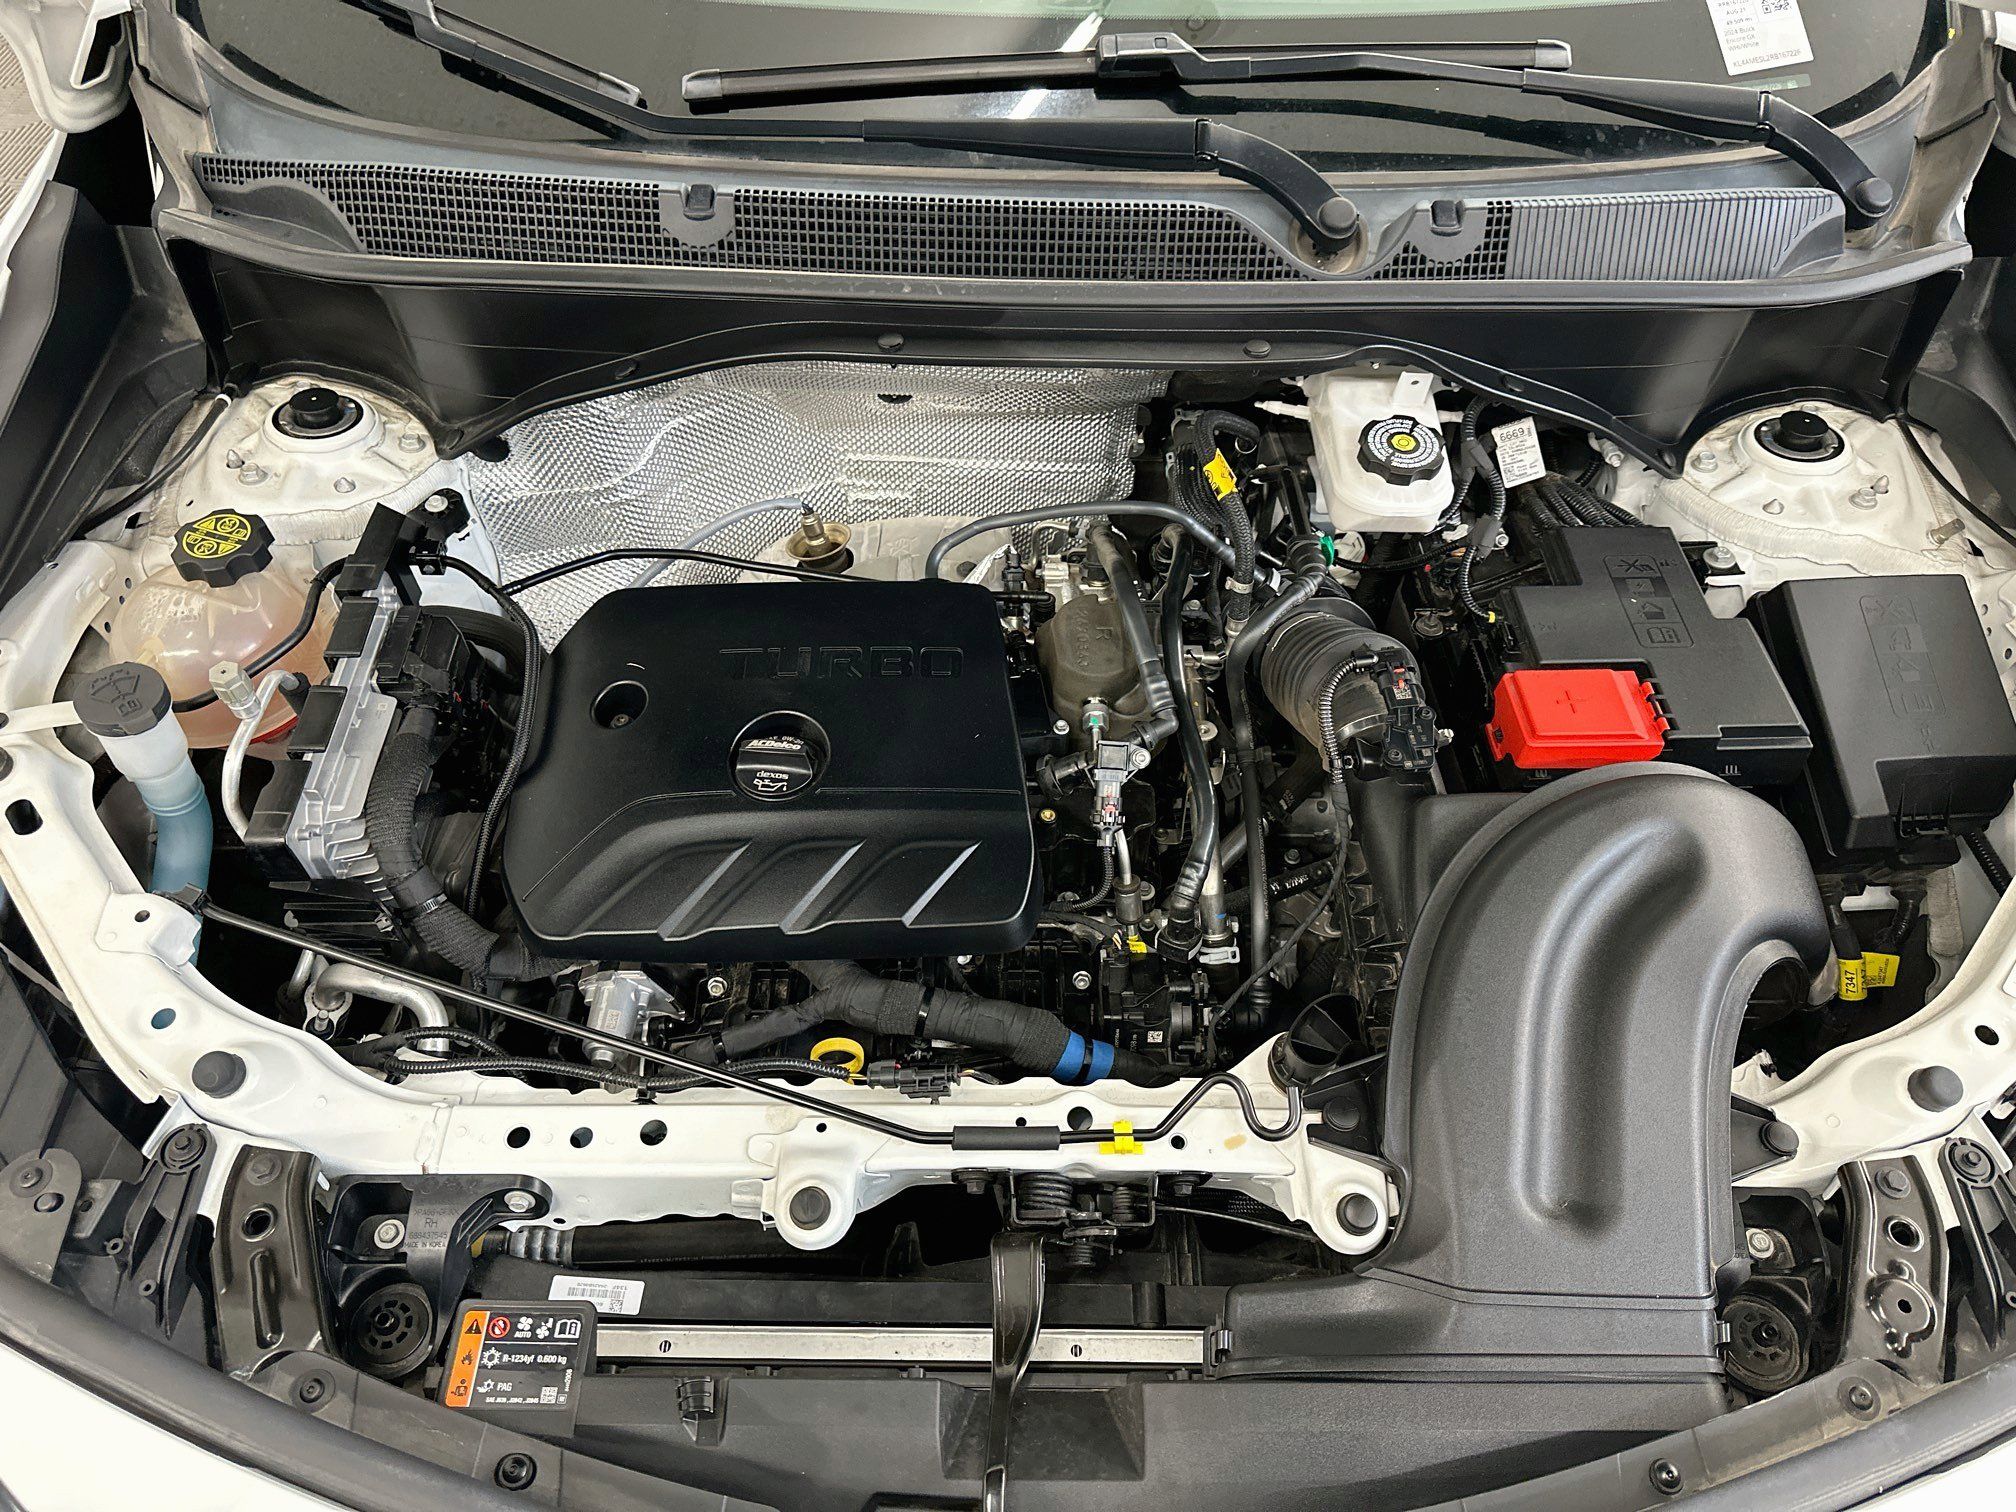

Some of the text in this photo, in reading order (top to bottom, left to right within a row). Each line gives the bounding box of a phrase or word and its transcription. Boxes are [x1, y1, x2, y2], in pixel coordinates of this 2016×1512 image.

[1739, 26, 1756, 34] Buick
[1500, 427, 1525, 442] 6669
[720, 646, 963, 678] TURBO
[745, 740, 801, 750] ACDelco
[756, 770, 789, 780] dexos
[1844, 970, 1856, 994] 7347
[424, 1218, 438, 1228] RH
[502, 1354, 568, 1365] R-1234yf 0.600 kg
[497, 1382, 513, 1392] PAG
